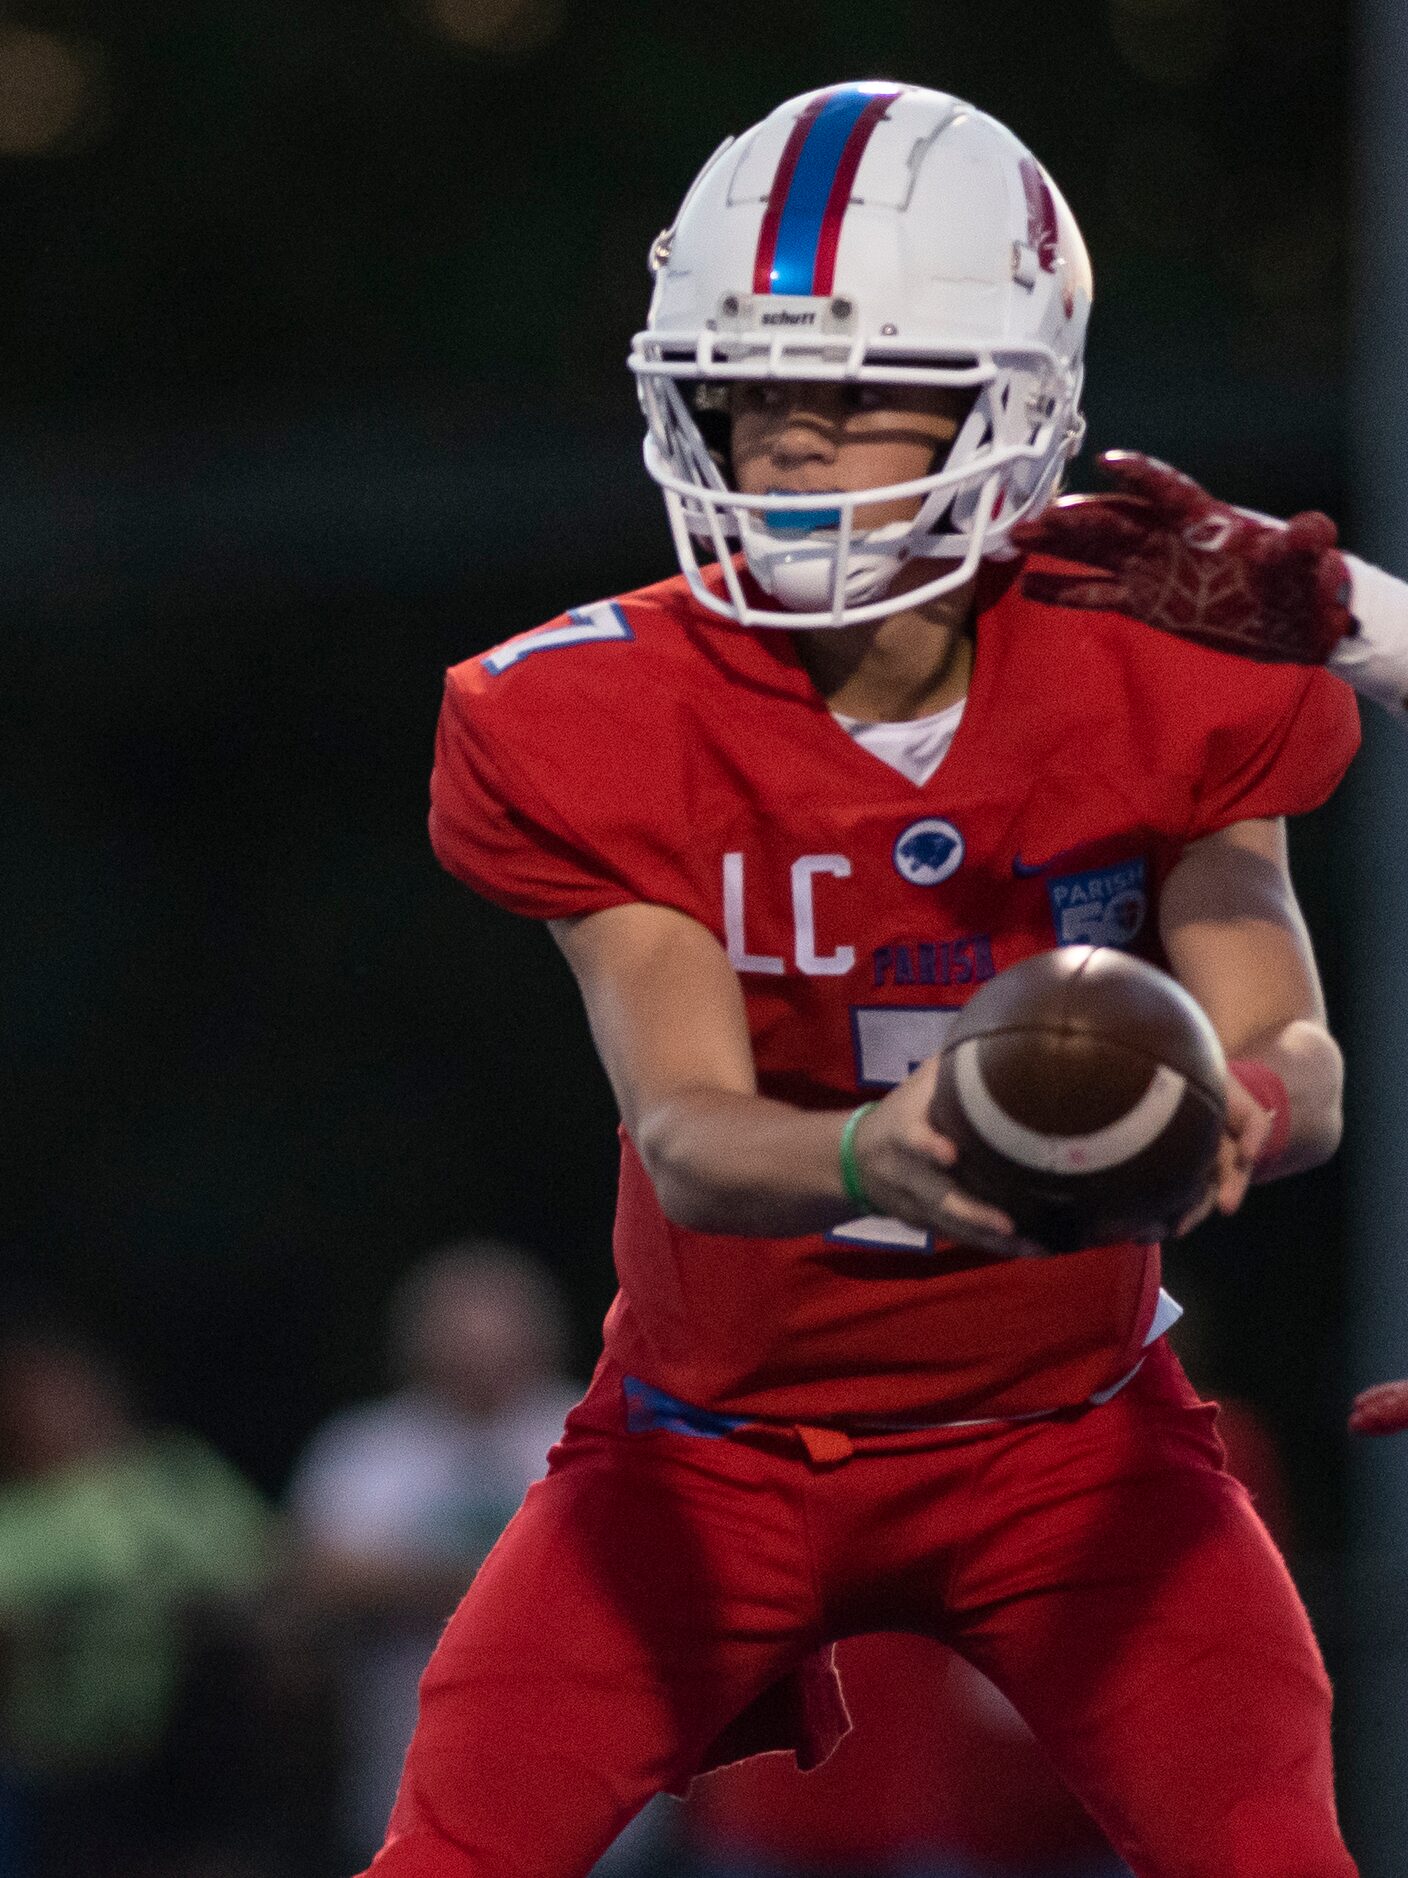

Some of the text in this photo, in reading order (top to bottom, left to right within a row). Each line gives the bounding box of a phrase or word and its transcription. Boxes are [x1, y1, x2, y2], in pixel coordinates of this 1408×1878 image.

[481, 599, 635, 677] 7
[723, 850, 856, 976] LC
[1053, 862, 1145, 908] PARISH
[1061, 888, 1147, 946] 50
[873, 932, 996, 987] PARISH
